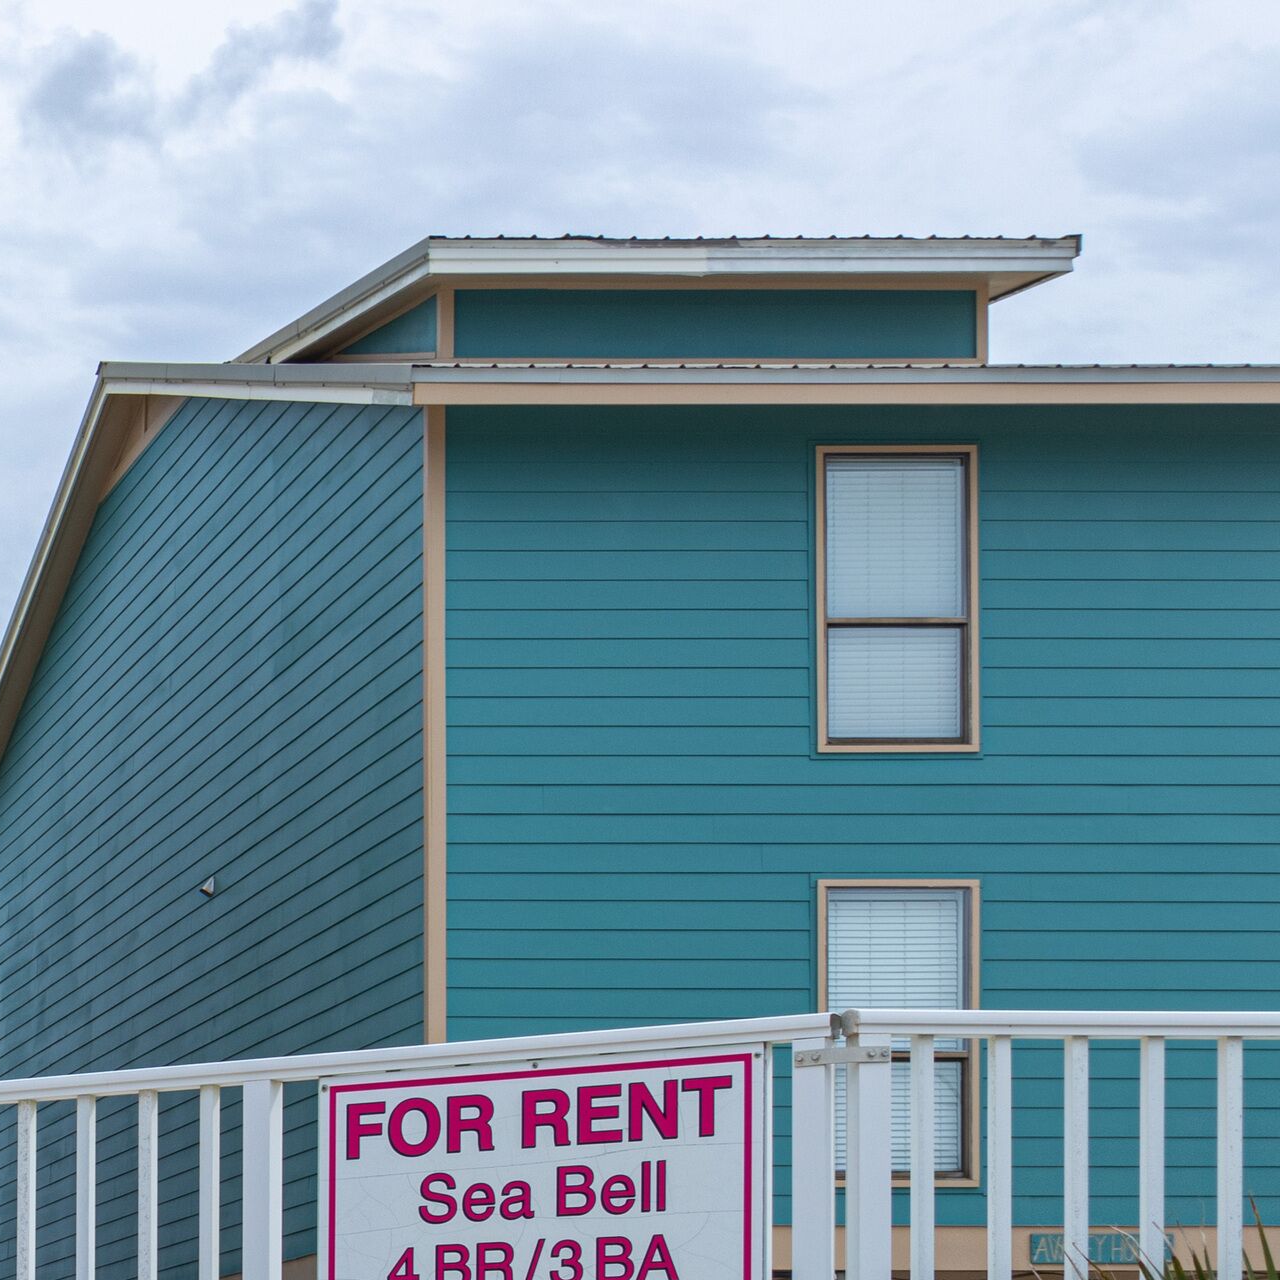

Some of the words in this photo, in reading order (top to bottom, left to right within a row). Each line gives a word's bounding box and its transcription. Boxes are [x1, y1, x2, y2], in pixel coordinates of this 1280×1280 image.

[346, 1094, 495, 1160] FOR
[521, 1075, 733, 1149] RENT
[418, 1172, 535, 1225] Sea
[556, 1159, 667, 1217] Bell
